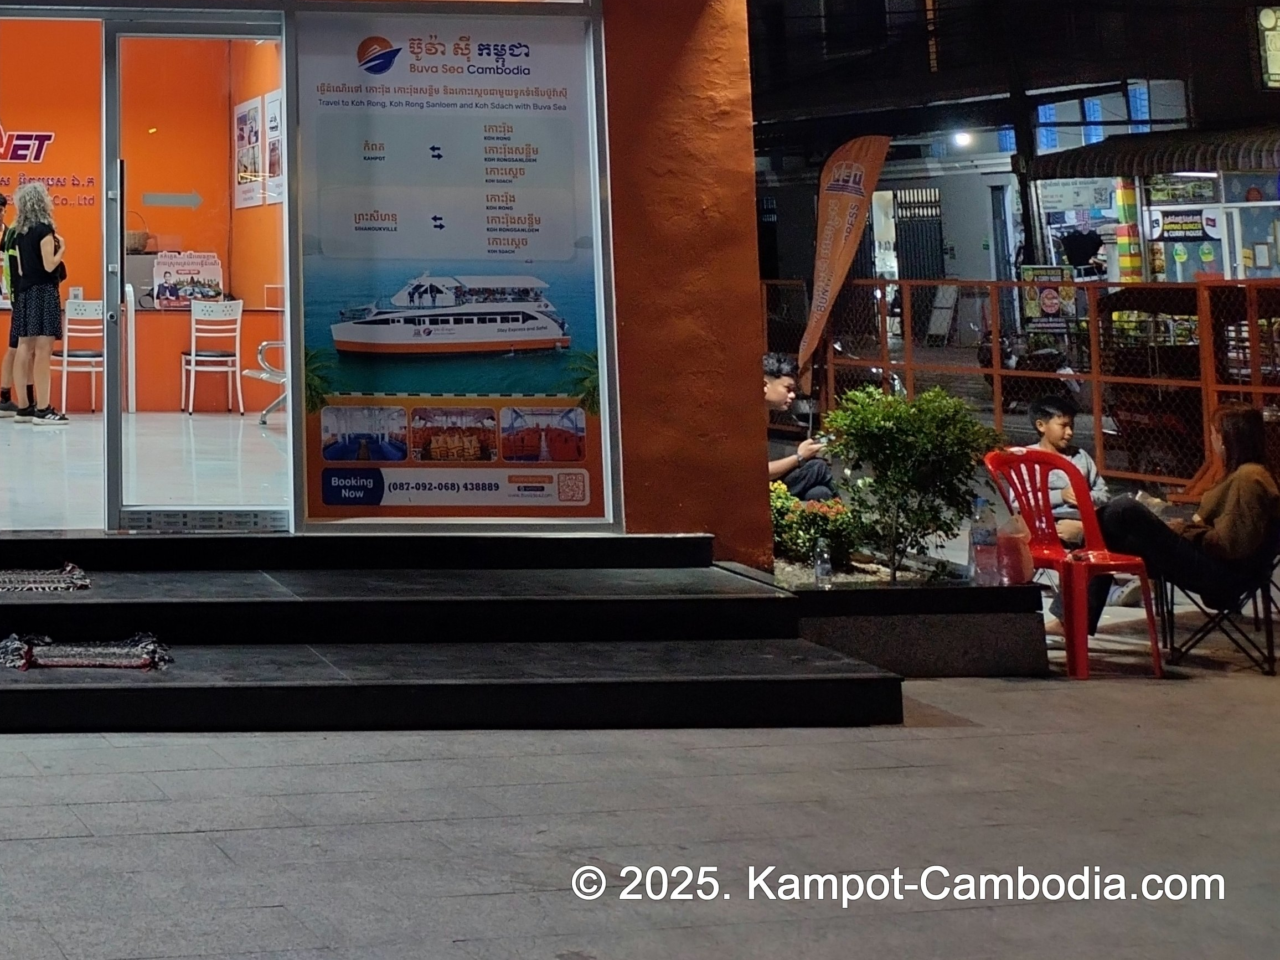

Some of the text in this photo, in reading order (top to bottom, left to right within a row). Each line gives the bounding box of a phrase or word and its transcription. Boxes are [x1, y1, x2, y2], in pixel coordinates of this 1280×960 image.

[477, 41, 531, 68] កម្ពុជា
[409, 64, 531, 76] Buva Sea Cambodia
[319, 98, 341, 107] Travel
[342, 99, 350, 107] to
[351, 99, 366, 108] Koh
[389, 100, 404, 109] Koh
[405, 100, 424, 110] Rong
[426, 100, 458, 110] Sanloem
[459, 101, 473, 110] and
[475, 102, 490, 110] Koh
[491, 102, 514, 111] Sdach
[515, 102, 531, 111] with
[533, 103, 552, 111] Buva
[553, 103, 567, 111] Sea
[834, 170, 862, 185] VET
[78, 195, 95, 205] Ltd
[331, 477, 374, 488] Booking
[387, 481, 460, 493] (087-092-068)
[341, 489, 365, 499] Now
